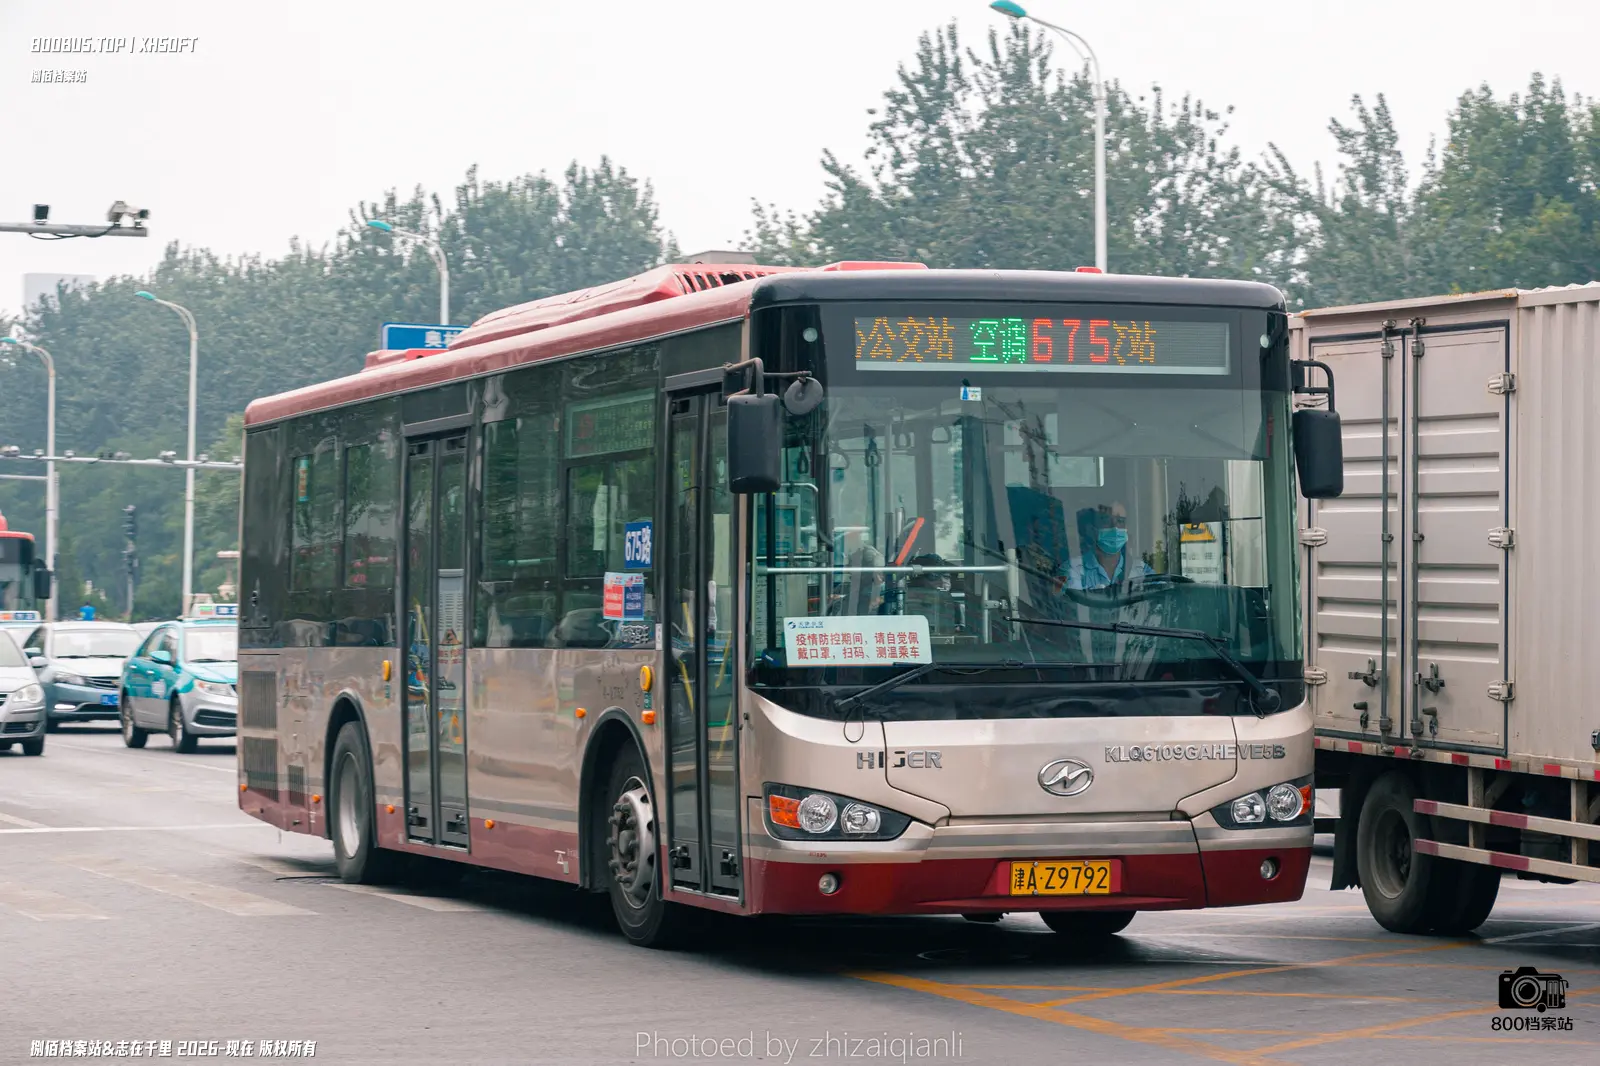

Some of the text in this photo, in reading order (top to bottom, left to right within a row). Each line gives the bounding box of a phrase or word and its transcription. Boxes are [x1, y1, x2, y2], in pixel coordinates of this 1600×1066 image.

[970, 318, 1026, 364] 空调
[1032, 318, 1110, 362] 675
[625, 525, 652, 565] 675路
[1104, 744, 1286, 763] KLQ6109GAHEVE5B
